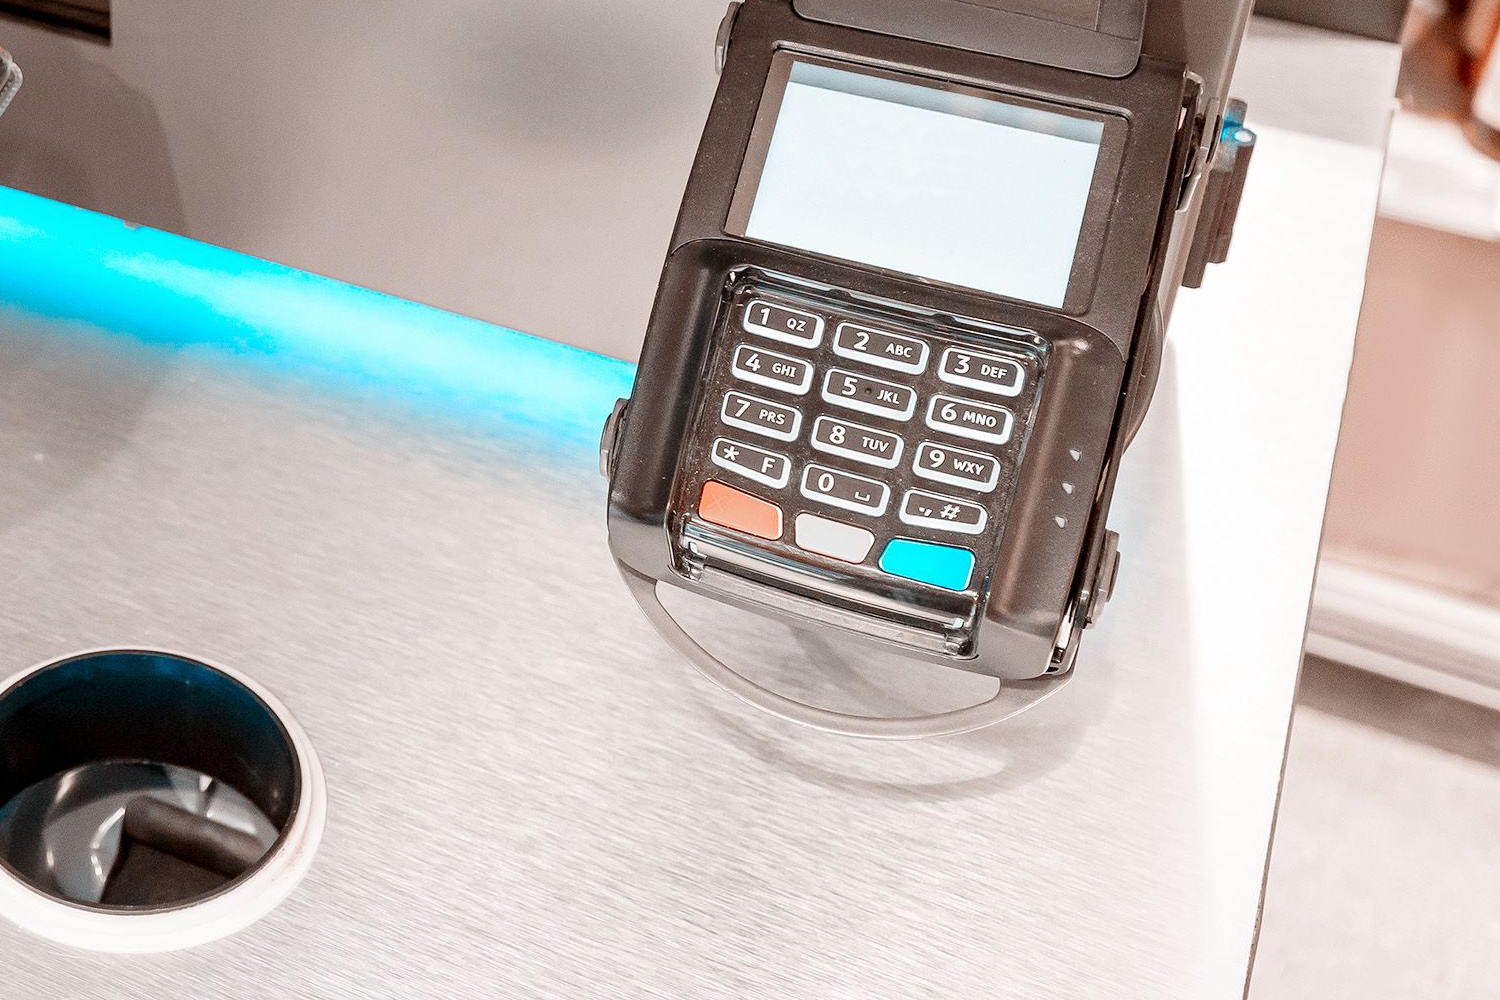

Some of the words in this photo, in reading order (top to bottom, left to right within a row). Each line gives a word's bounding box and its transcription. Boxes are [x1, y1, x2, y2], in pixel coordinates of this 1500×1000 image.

[760, 307, 771, 326] 1
[786, 317, 807, 332] QZ
[853, 331, 870, 351] 2
[884, 343, 913, 359] ABC
[745, 353, 761, 372] 4
[771, 362, 797, 378] GHI
[954, 354, 971, 374] 3
[980, 364, 1008, 379] DEF
[841, 376, 858, 396] 5
[876, 389, 900, 405] JKL
[734, 398, 751, 418] 7
[758, 408, 786, 425] PRS
[940, 402, 958, 422] 6
[962, 410, 997, 428] MNO
[829, 425, 846, 445] 8
[861, 436, 890, 453] TUV
[761, 456, 776, 474] F
[929, 449, 946, 468] 9
[953, 458, 985, 476] WXY
[817, 472, 835, 492] 0
